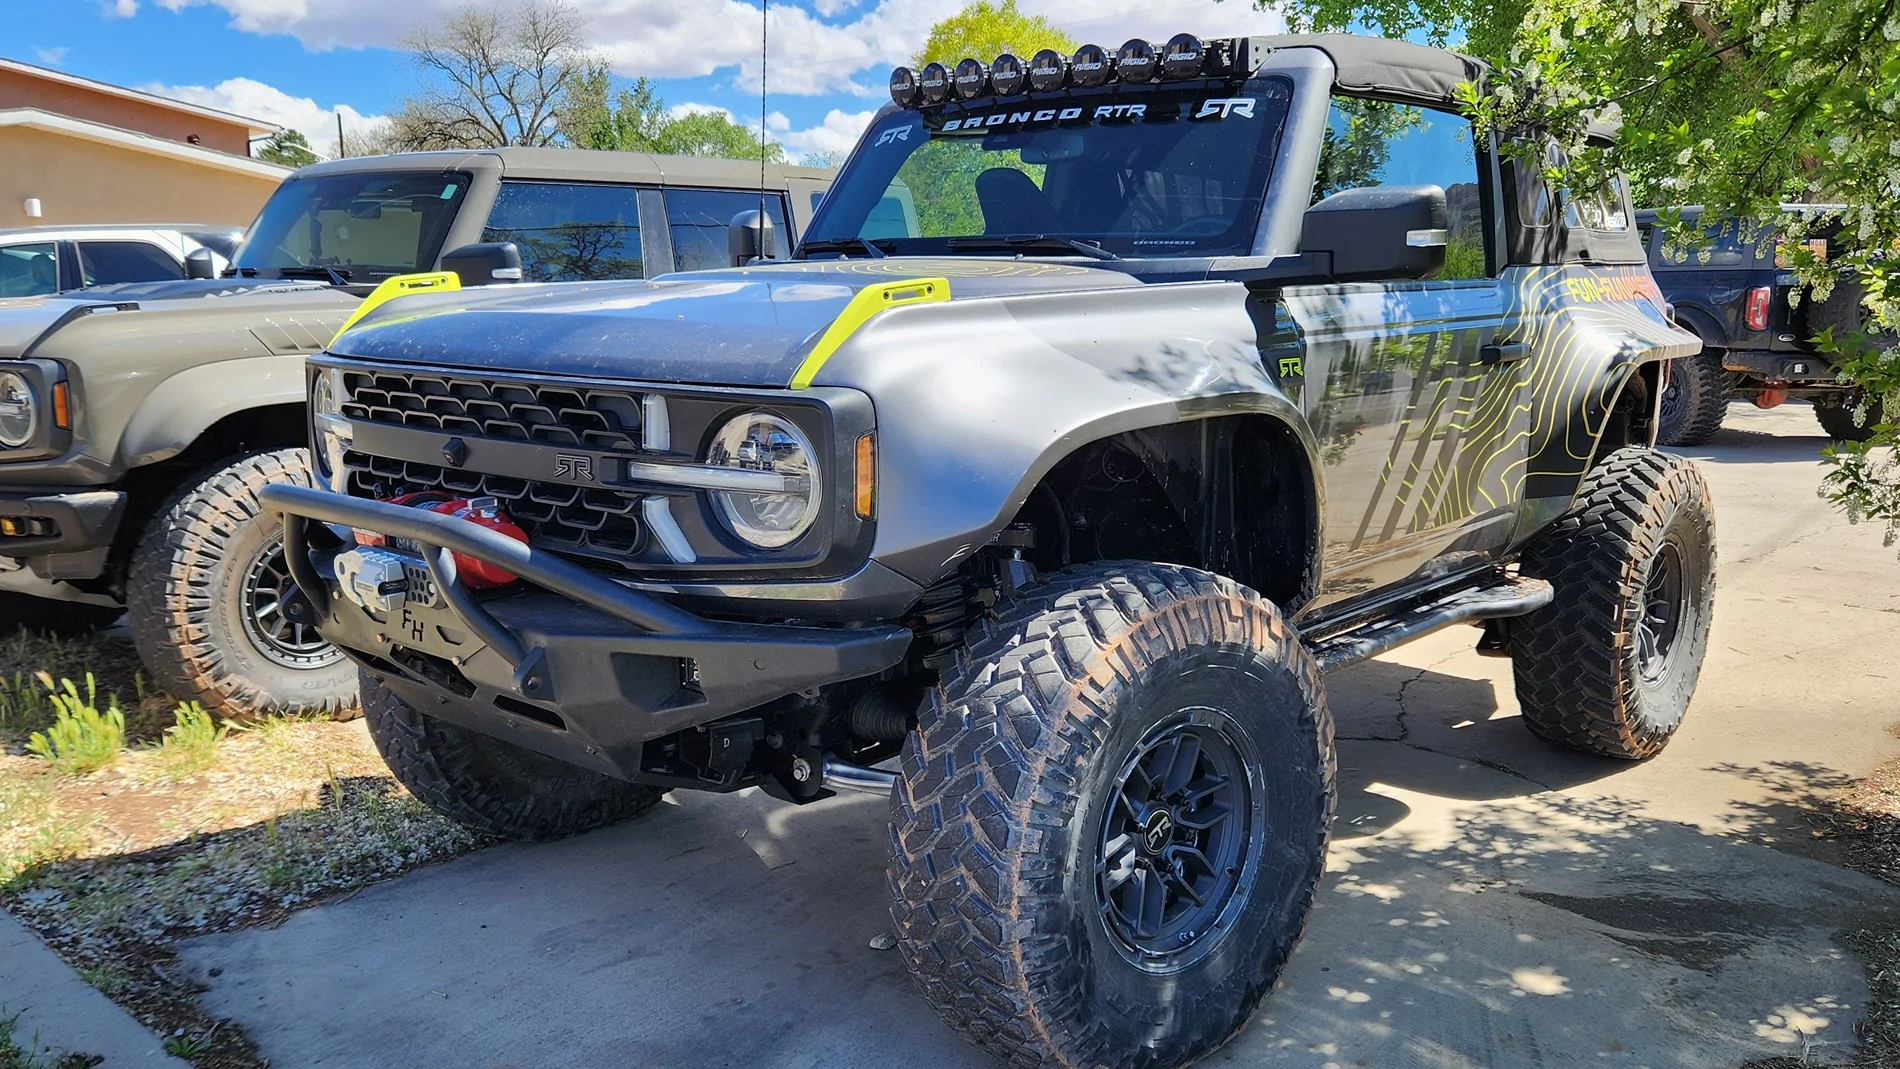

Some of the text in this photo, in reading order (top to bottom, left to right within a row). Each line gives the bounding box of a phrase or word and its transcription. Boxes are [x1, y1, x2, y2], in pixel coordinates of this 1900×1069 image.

[1166, 52, 1197, 62] RIGID
[1074, 62, 1102, 71] RIGID
[1119, 57, 1149, 67] RIGID
[993, 71, 1017, 80] RIGID
[1032, 67, 1058, 75] RIGID
[923, 79, 943, 88] RIGID
[956, 75, 979, 84] RIGID
[941, 103, 1148, 132] BRONCO RTR
